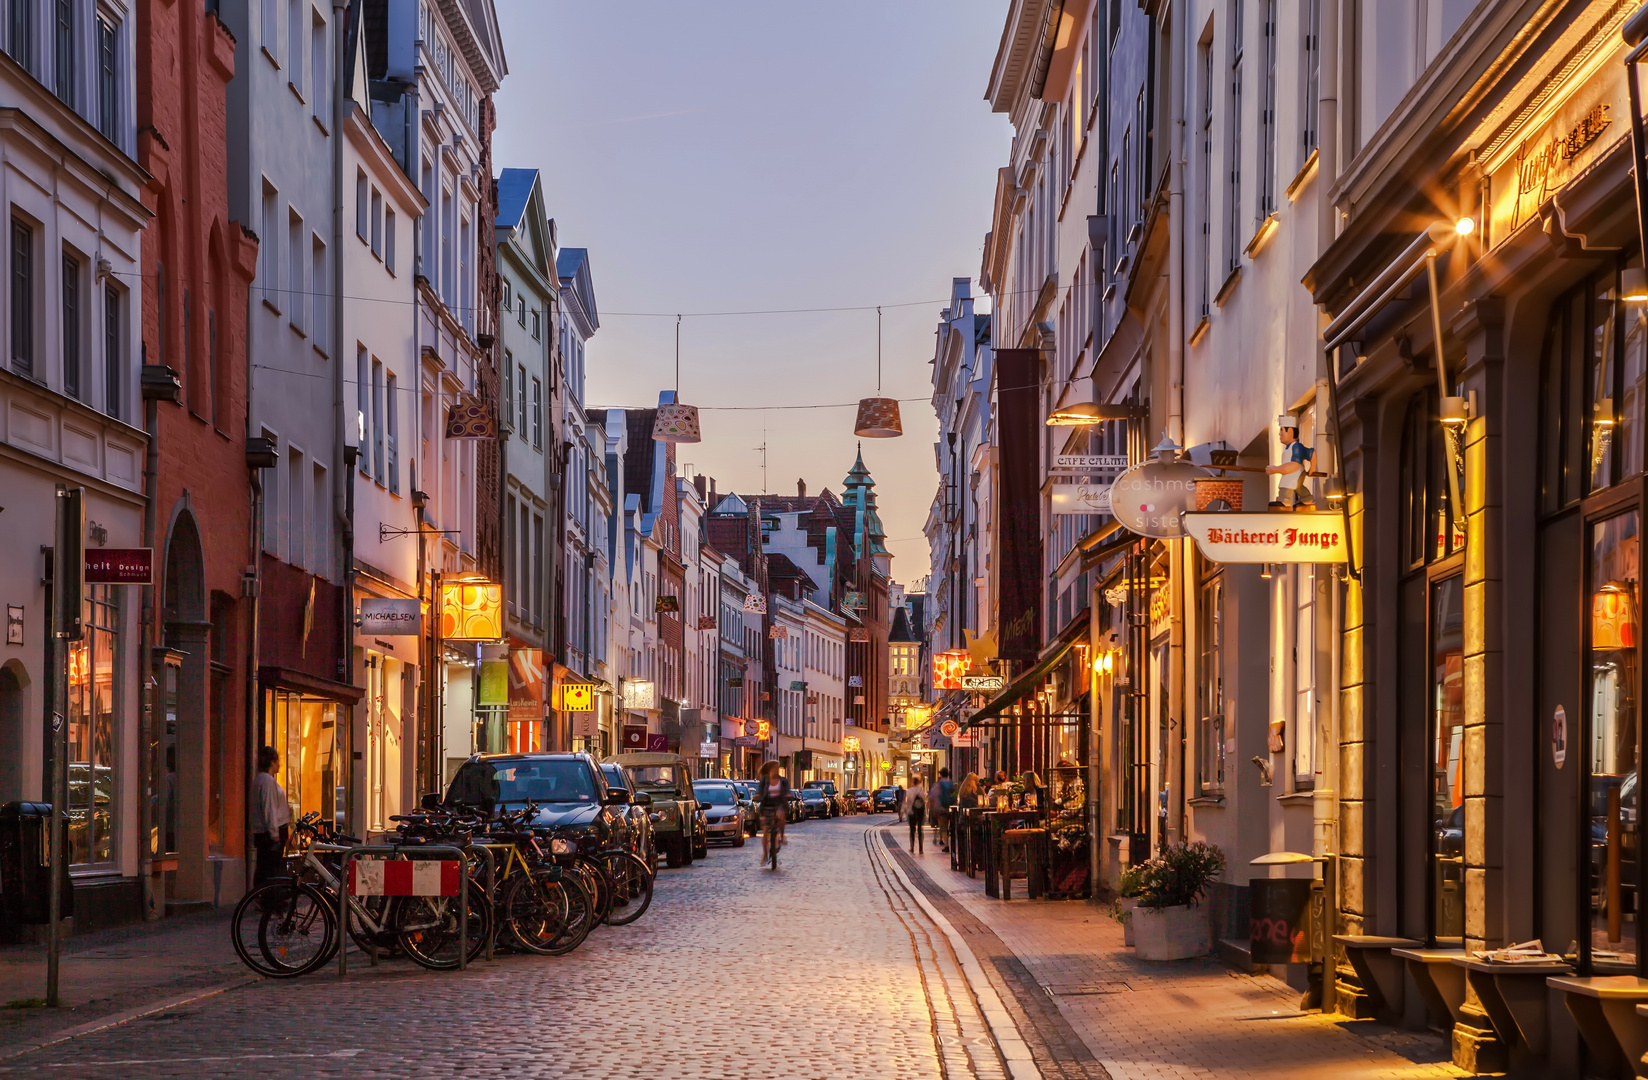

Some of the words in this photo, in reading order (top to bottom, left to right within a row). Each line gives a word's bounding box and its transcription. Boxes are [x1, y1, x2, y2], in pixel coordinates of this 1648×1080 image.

[1057, 457, 1086, 466] CAFE
[1207, 527, 1280, 544] Bäckerei
[1284, 527, 1339, 547] Junge
[365, 612, 416, 622] MICHAELSEN
